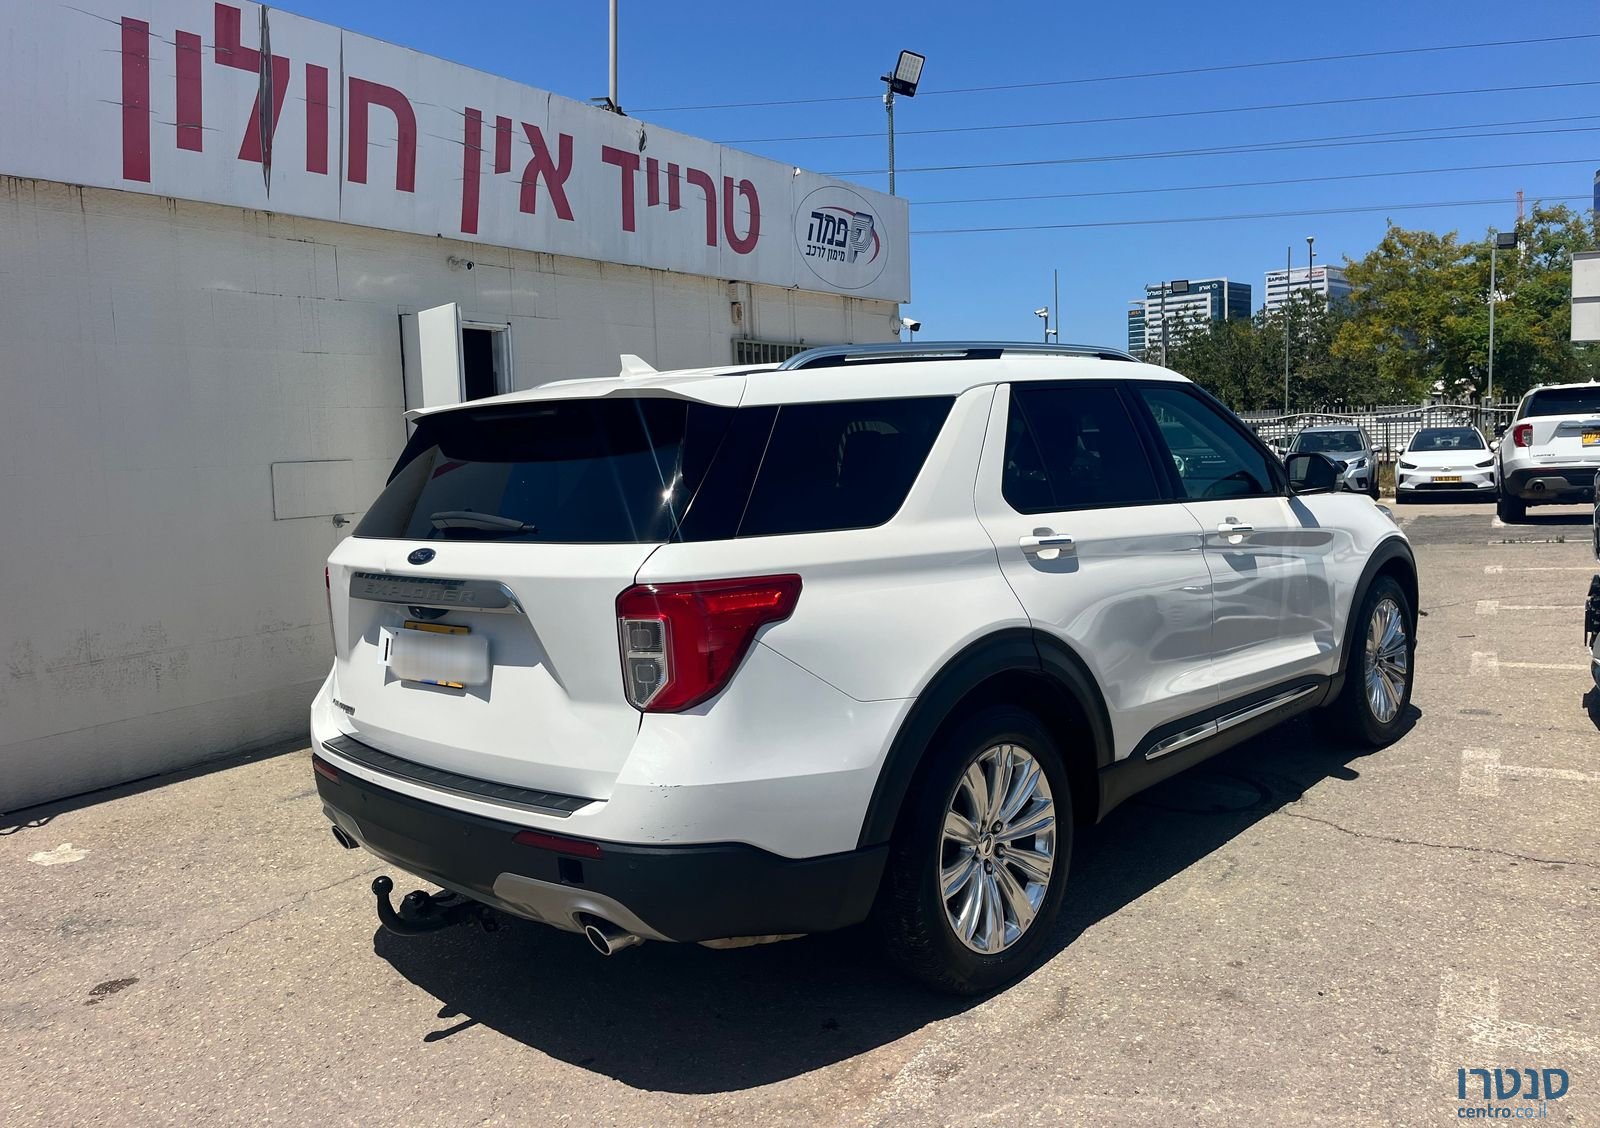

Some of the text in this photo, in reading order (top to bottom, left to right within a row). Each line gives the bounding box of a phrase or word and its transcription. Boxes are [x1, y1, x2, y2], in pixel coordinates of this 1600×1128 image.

[121, 2, 761, 255] טרייד אין חולון
[807, 211, 849, 249] פמה
[805, 244, 846, 263] מימון לרכב
